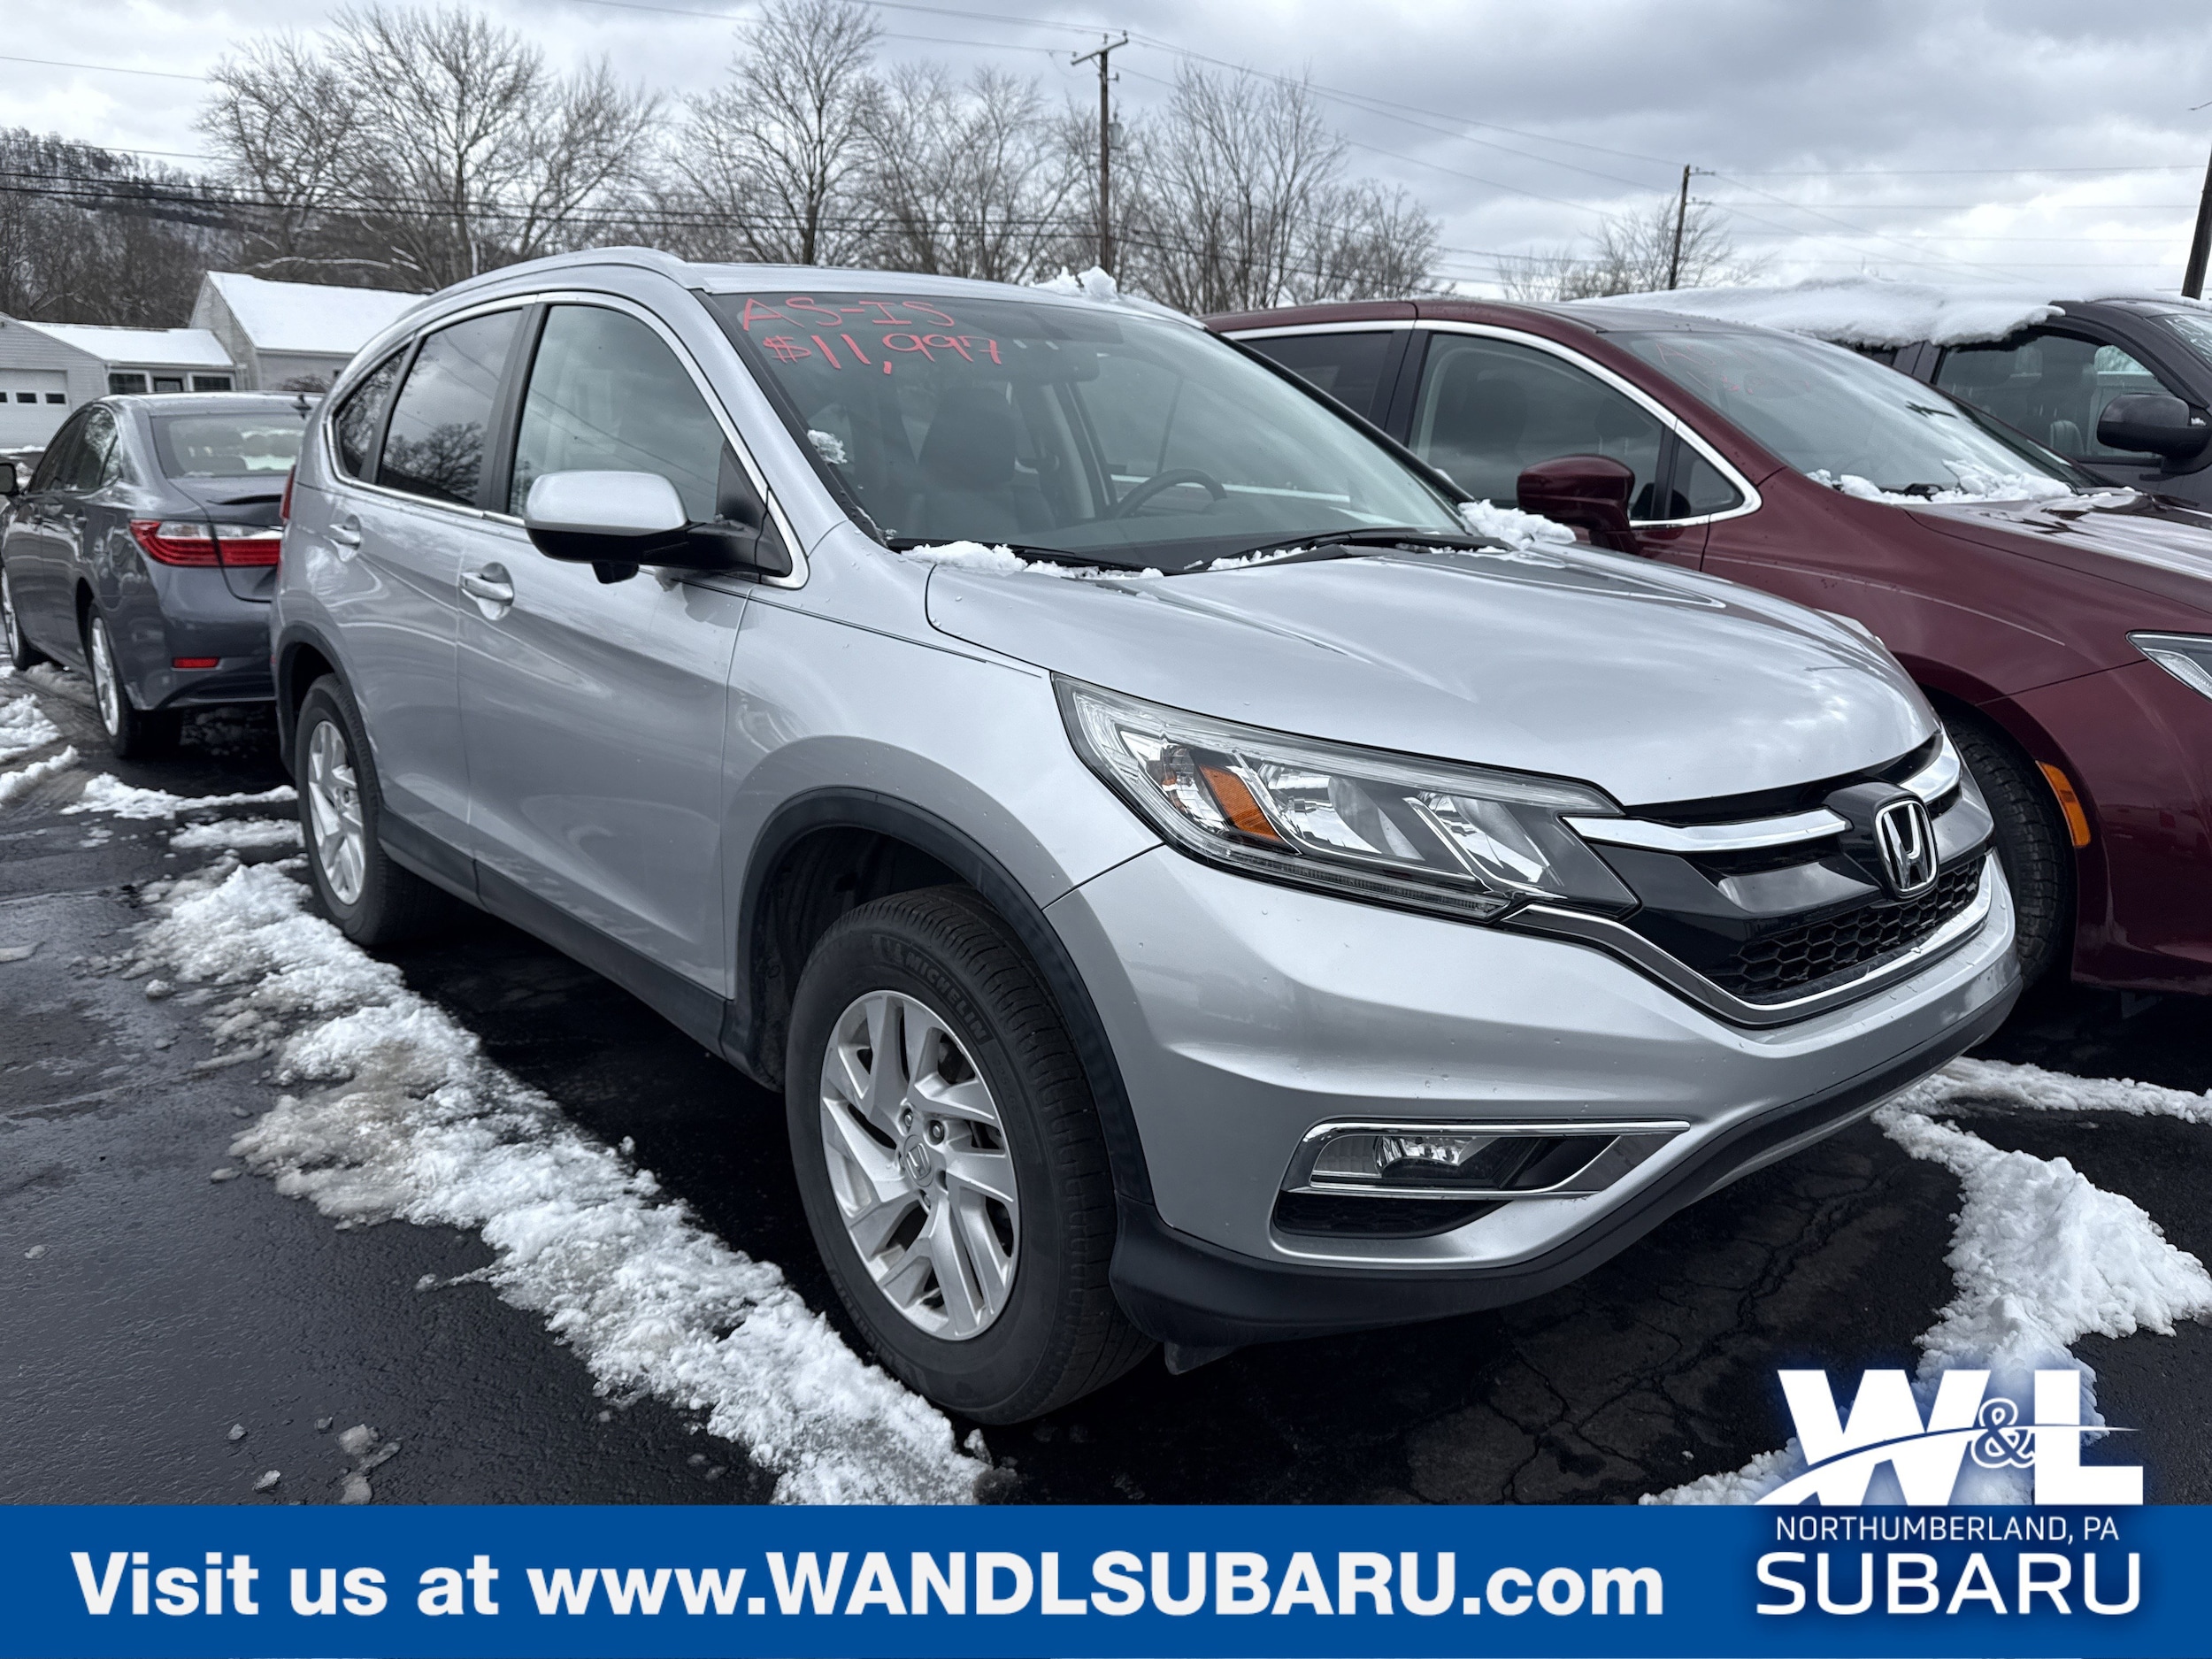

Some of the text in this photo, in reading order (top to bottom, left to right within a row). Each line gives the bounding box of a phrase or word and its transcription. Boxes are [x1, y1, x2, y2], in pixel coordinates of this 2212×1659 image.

[742, 297, 955, 332] AS-IS
[762, 333, 1002, 374] $11,997
[906, 951, 988, 1041] MICHELIN
